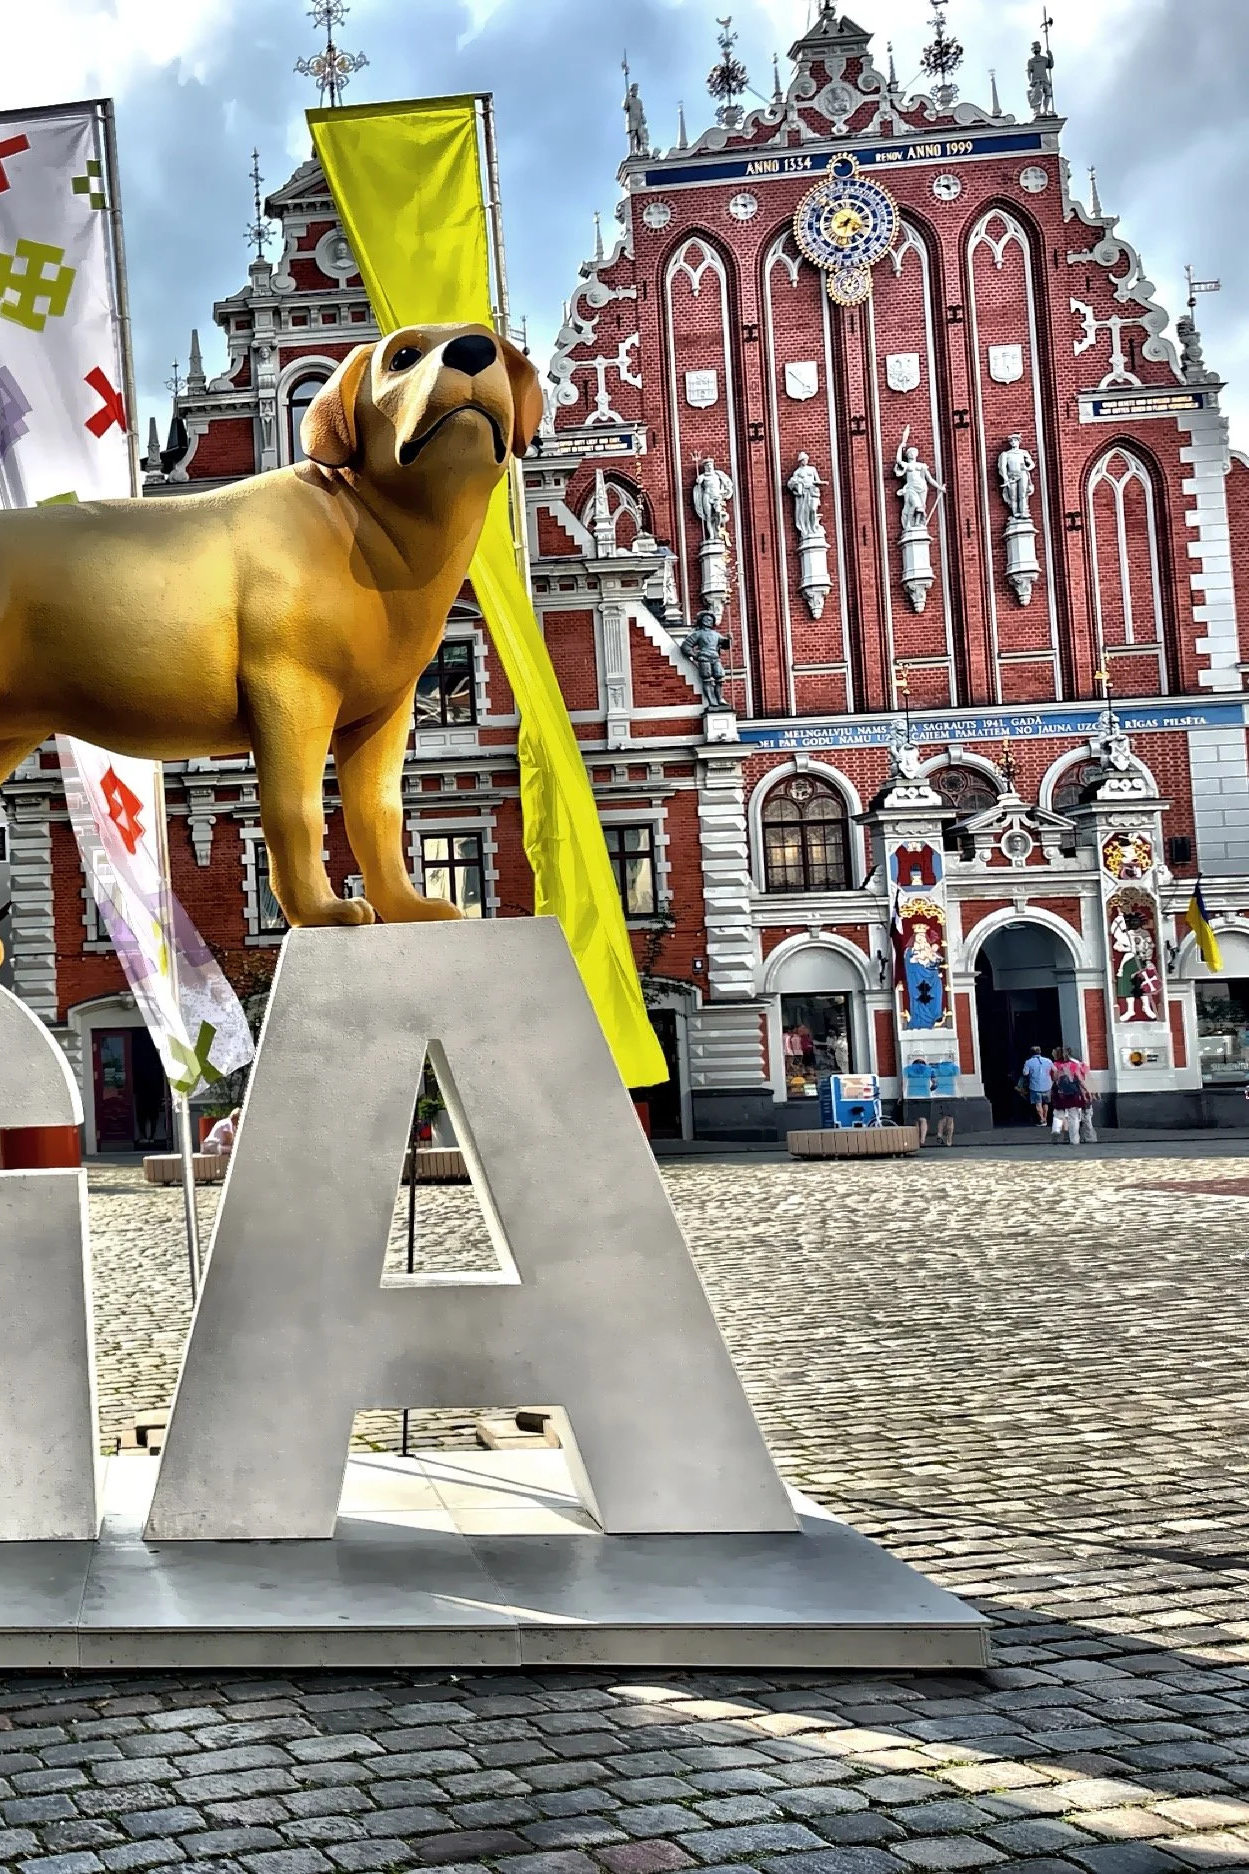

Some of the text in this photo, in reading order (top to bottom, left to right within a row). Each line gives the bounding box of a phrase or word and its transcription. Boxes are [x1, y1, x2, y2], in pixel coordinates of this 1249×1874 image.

[906, 143, 942, 160] ANNO
[946, 140, 973, 155] 1999
[745, 156, 812, 176] ANNO 1334
[779, 739, 798, 748] PAR
[802, 737, 834, 746] GODU
[840, 735, 872, 745] NAMU
[955, 727, 1010, 739] PAMATIEM
[1016, 725, 1032, 735] NO
[1037, 723, 1072, 735] JAUNA
[857, 725, 887, 735] NAMS
[923, 720, 977, 731] SAGRAUTS
